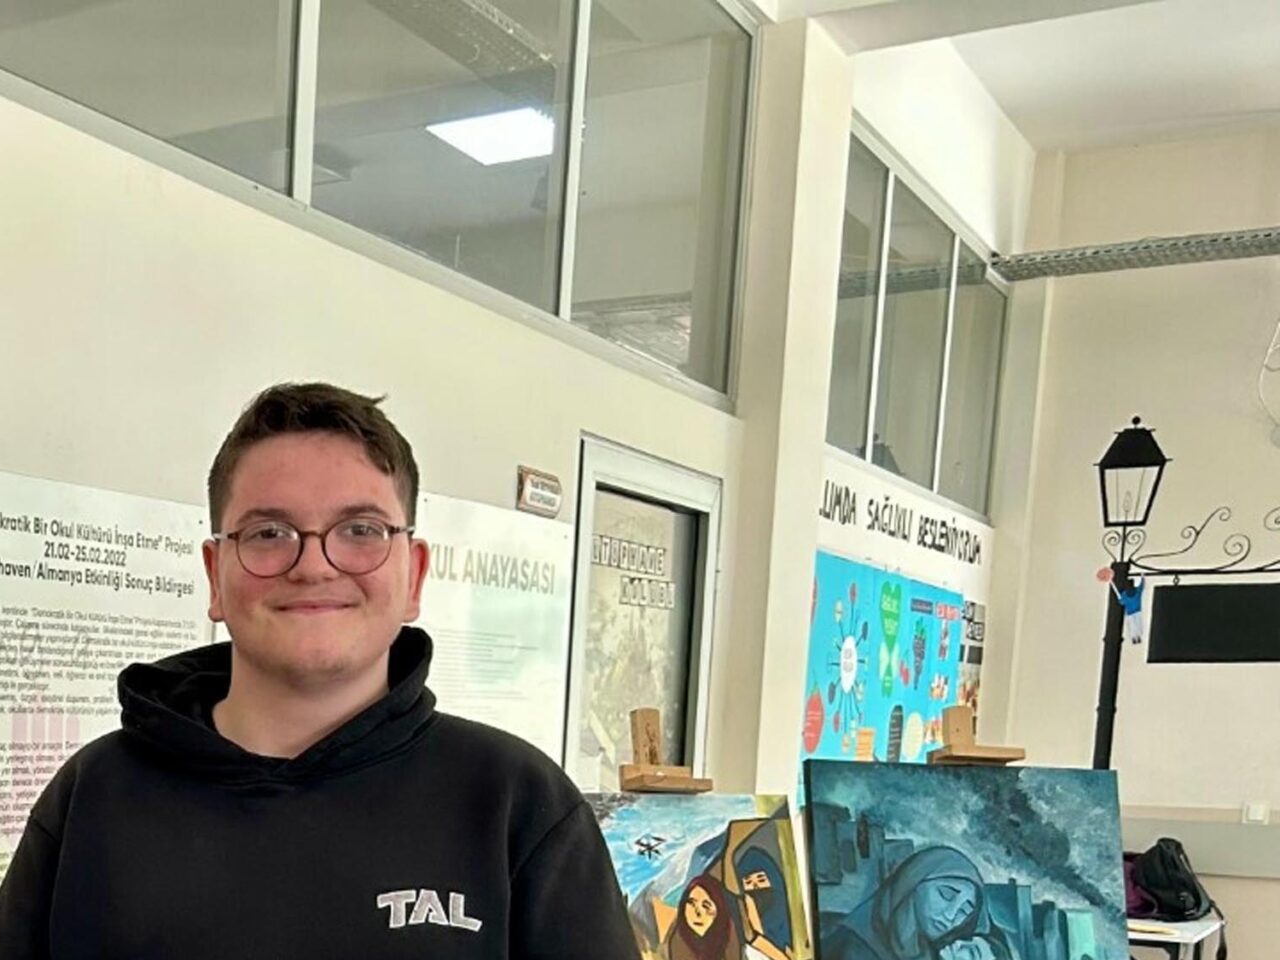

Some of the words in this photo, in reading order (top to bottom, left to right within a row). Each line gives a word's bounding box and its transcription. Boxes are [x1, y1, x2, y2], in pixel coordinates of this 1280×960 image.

[33, 517, 48, 535] Bir
[50, 519, 74, 539] Okul
[164, 536, 194, 557] Projesi
[125, 572, 153, 595] Sonuç
[462, 551, 556, 595] ANAYASASI
[377, 889, 482, 932] TAL
